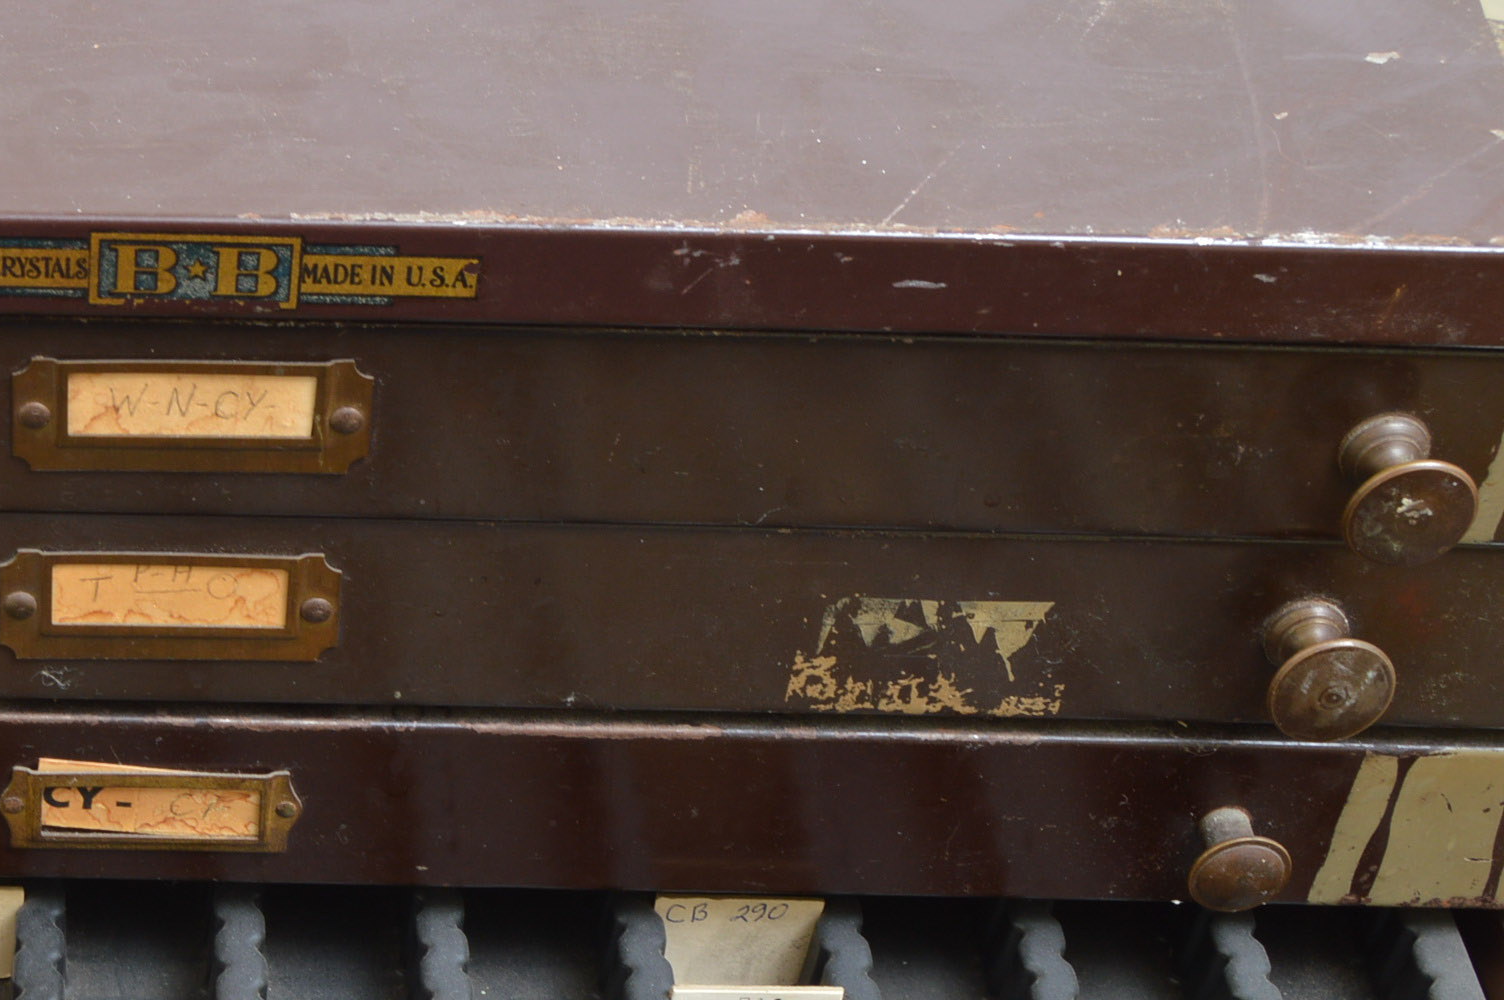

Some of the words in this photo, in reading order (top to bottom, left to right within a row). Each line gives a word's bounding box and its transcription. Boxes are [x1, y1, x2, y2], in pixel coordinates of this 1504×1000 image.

[110, 244, 178, 296] B
[210, 246, 279, 297] B
[302, 265, 363, 286] MADE
[369, 265, 394, 287] IN
